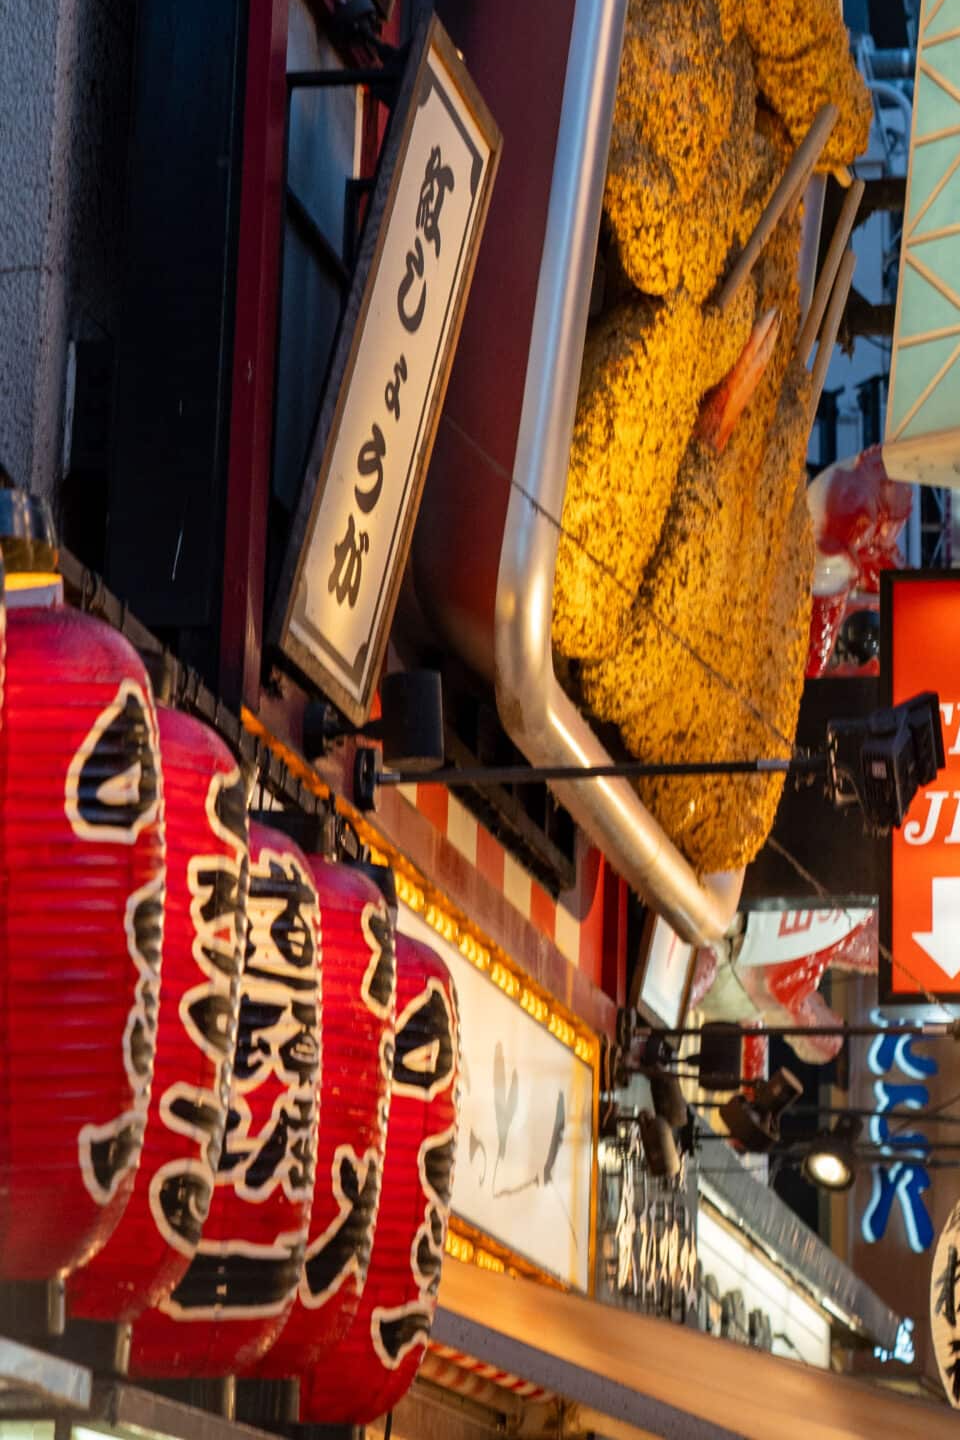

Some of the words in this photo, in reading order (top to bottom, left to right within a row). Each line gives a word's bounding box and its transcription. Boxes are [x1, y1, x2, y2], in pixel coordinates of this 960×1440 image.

[326, 144, 455, 610] 紅しょうが
